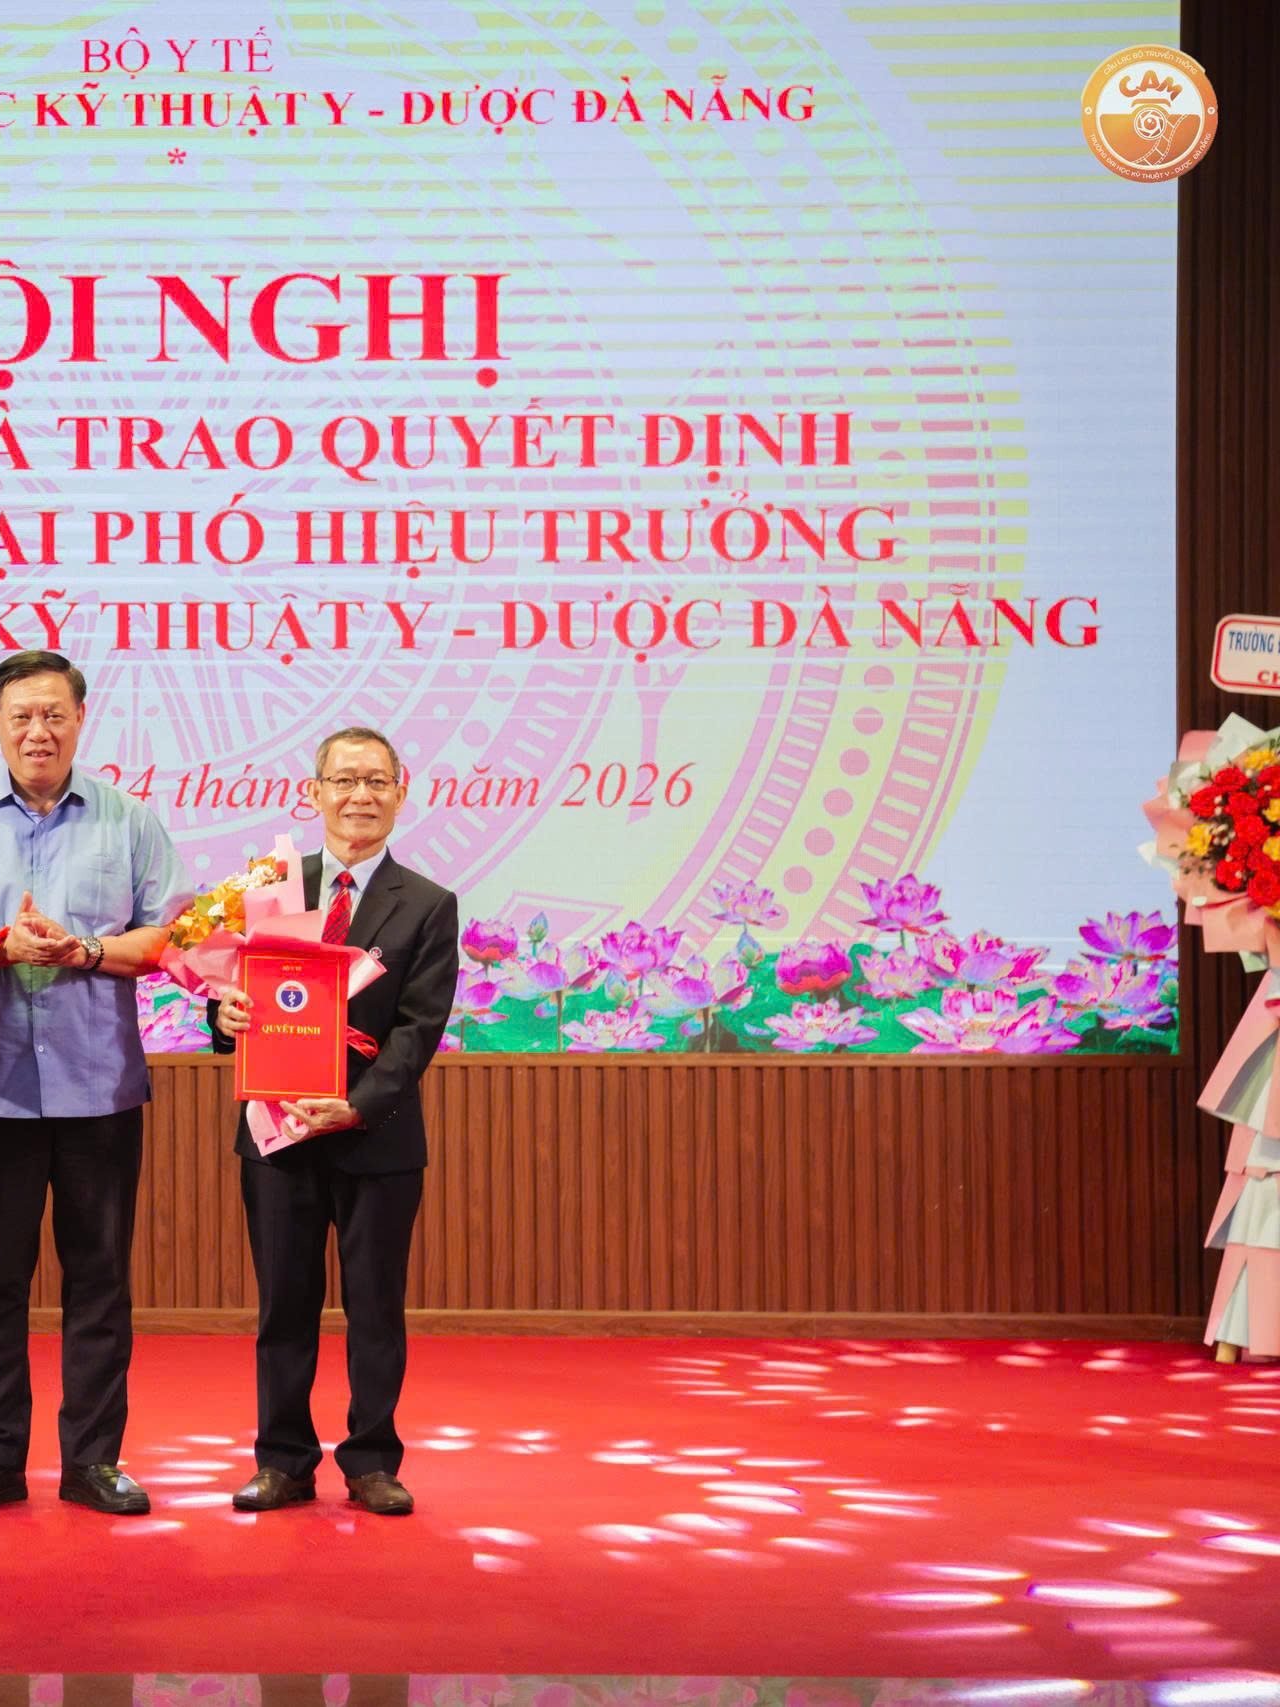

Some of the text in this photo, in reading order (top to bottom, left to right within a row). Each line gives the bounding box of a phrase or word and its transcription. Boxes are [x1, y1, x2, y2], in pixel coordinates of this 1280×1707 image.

[81, 26, 273, 79] BỘ Y TẾ
[32, 82, 108, 127] KỸ
[122, 85, 307, 137] THUẬT
[322, 92, 355, 126] Y
[402, 83, 556, 135] DƯỢC
[571, 75, 645, 123] ĐÀ
[661, 73, 816, 122] NẴNG
[147, 271, 511, 389] NGHỊ
[57, 415, 295, 471] TRAO
[320, 397, 615, 482] QUYẾT
[636, 411, 857, 484] ĐỊNH
[88, 493, 265, 566] PHÓ
[294, 503, 497, 580] HIỆU
[523, 489, 898, 563] TRƯỞNG
[100, 593, 365, 665] THUẬT
[384, 600, 437, 650] Y
[500, 590, 723, 664] DƯỢC
[744, 585, 852, 649] ĐÀ
[875, 583, 1103, 649] NẴNG
[427, 764, 540, 808] năm
[560, 761, 696, 808] 2026
[262, 1023, 320, 1036] QUYẾT ĐỊNH
